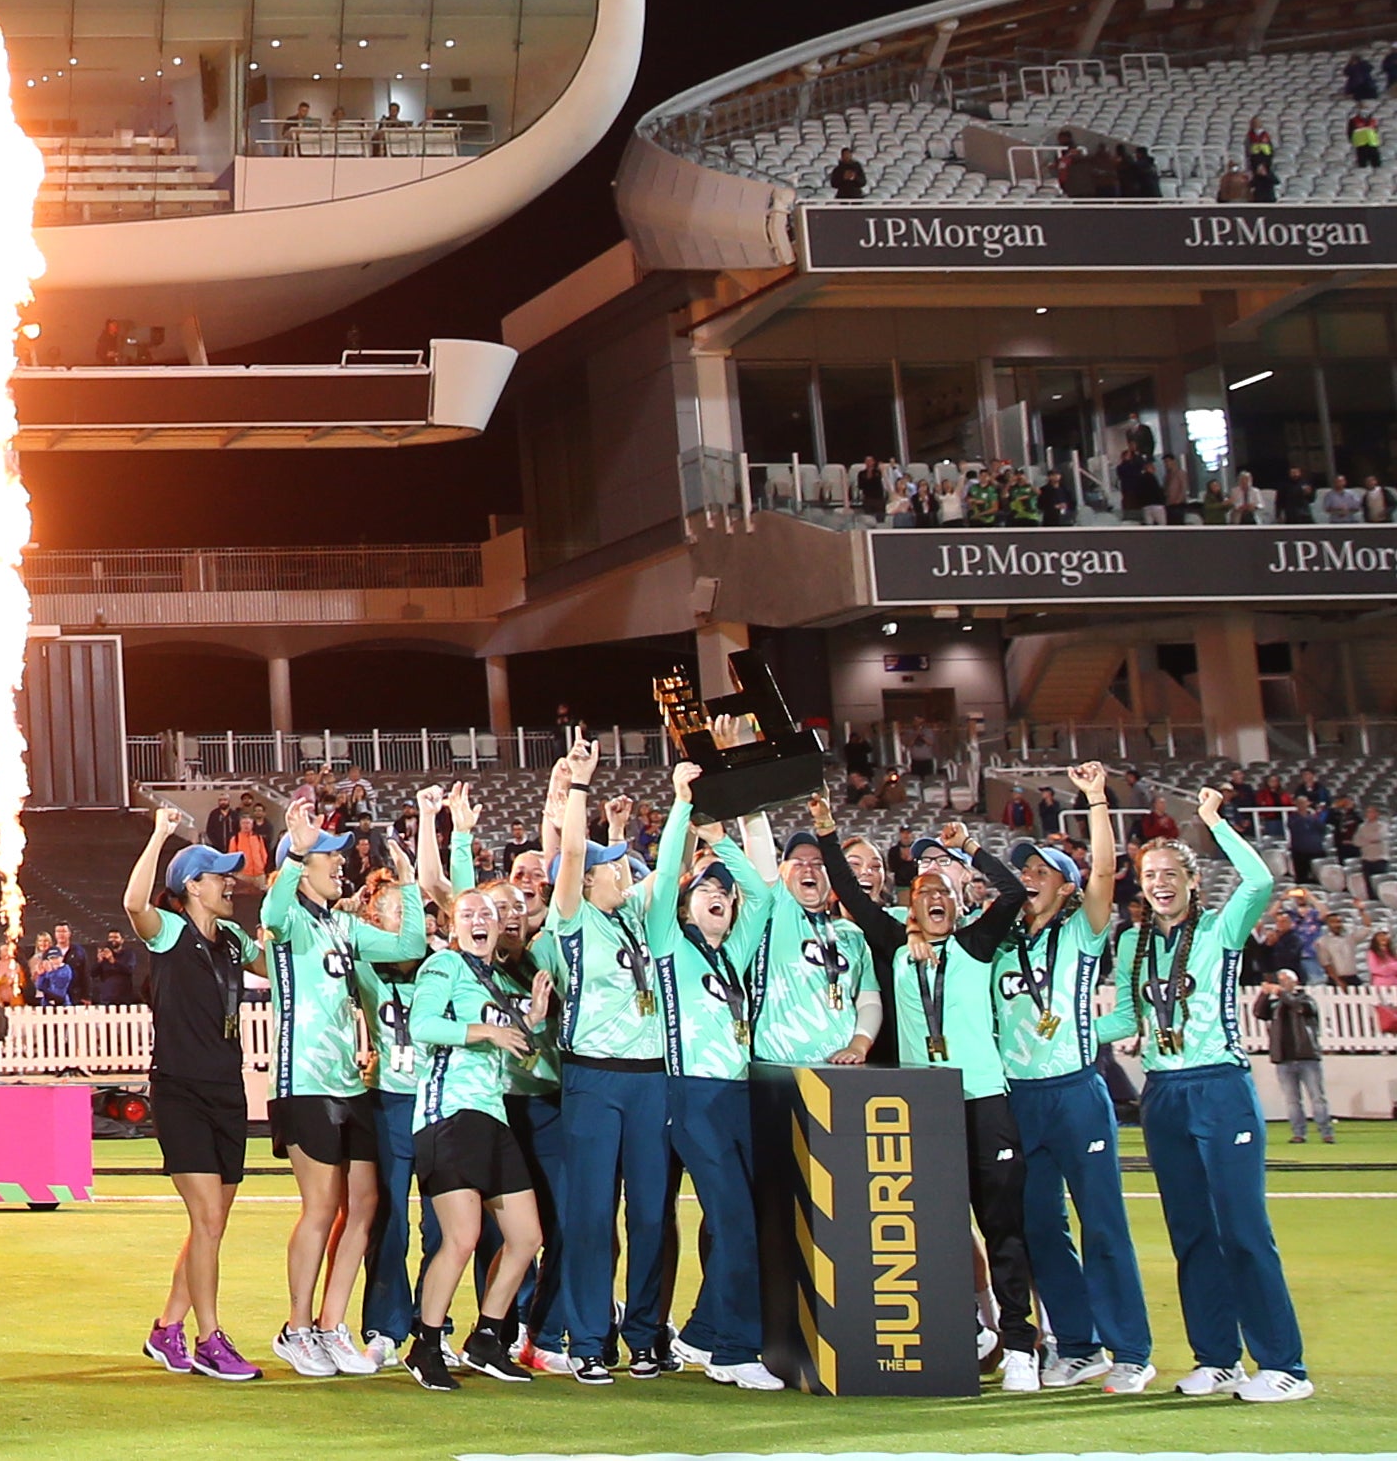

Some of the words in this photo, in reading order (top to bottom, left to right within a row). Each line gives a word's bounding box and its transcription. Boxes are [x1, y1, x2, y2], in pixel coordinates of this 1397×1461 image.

[859, 217, 1047, 258] J.P.Morgan
[1184, 216, 1370, 256] J.P.Morgan
[932, 544, 1127, 586] J.P.Morgan
[1269, 540, 1397, 578] J.P.Mor
[864, 1096, 923, 1371] HUNDRED
[877, 1359, 904, 1371] THE
